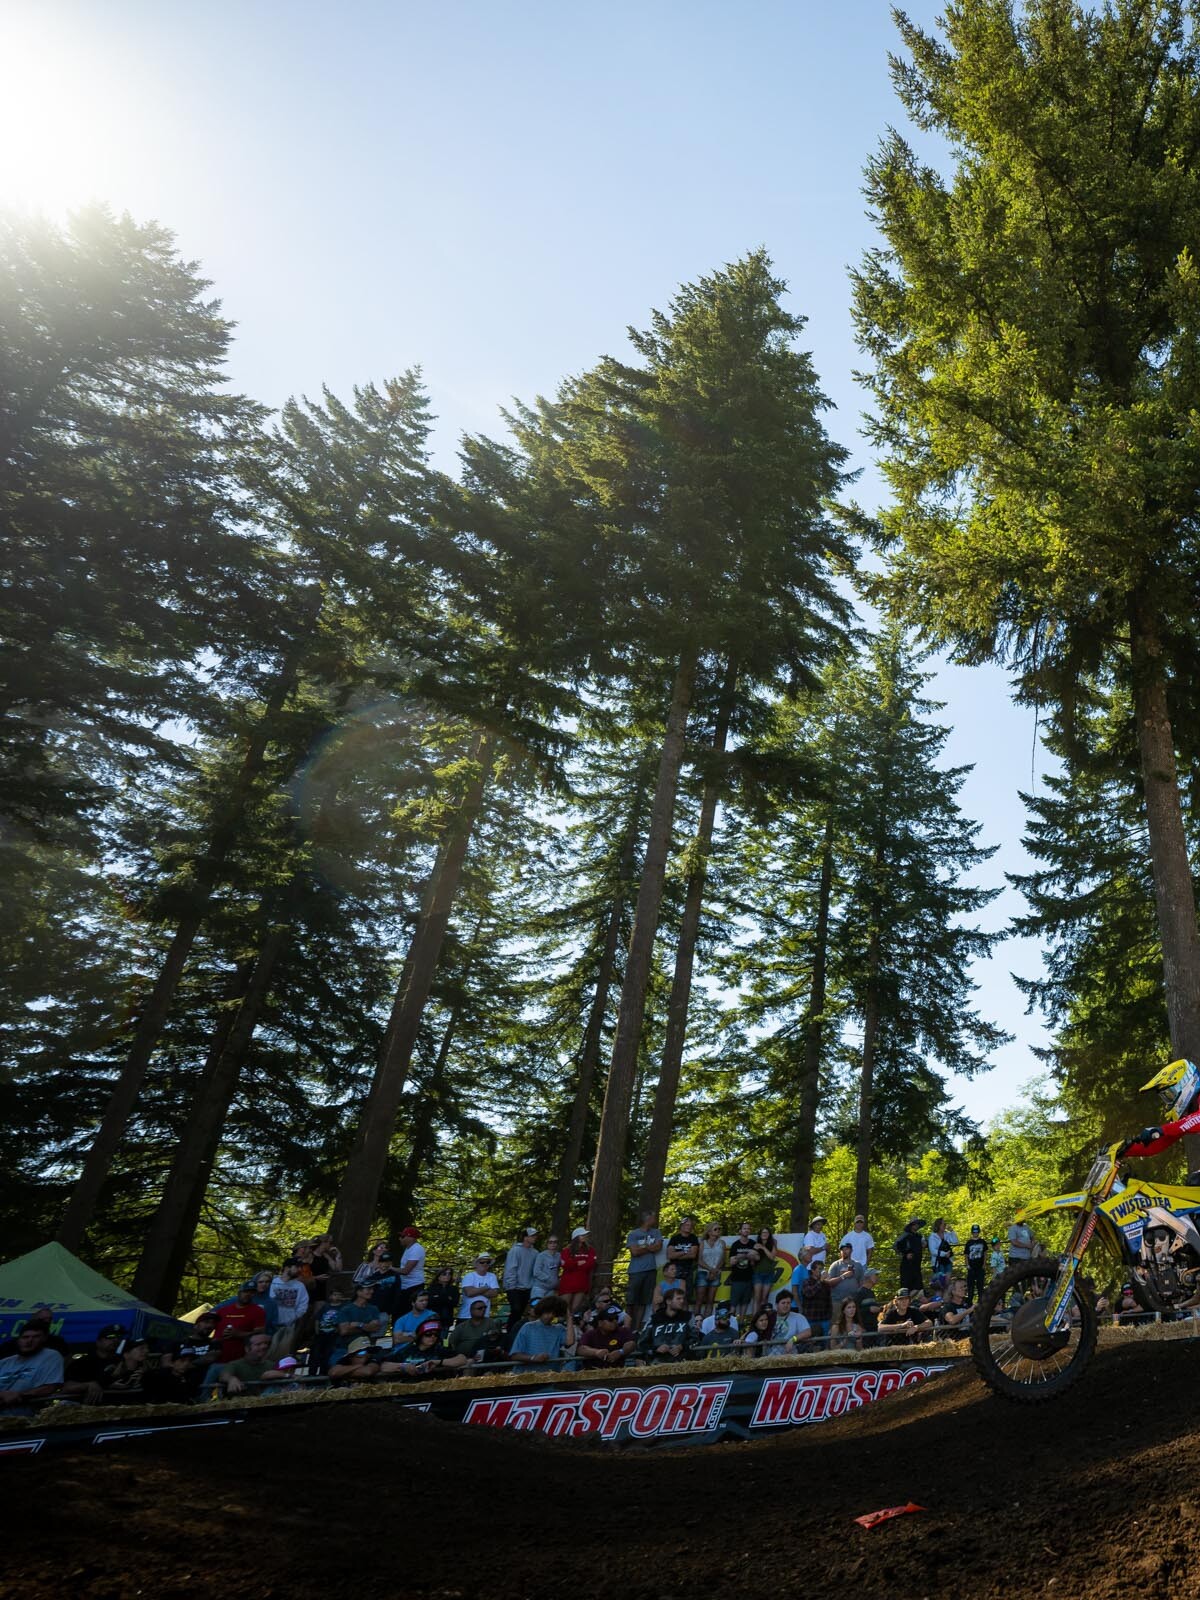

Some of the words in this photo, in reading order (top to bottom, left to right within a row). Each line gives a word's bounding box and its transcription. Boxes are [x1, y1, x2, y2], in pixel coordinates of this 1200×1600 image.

[1109, 1196, 1153, 1223] TWISTED
[1153, 1196, 1172, 1209] TEA
[655, 1322, 687, 1337] FOX
